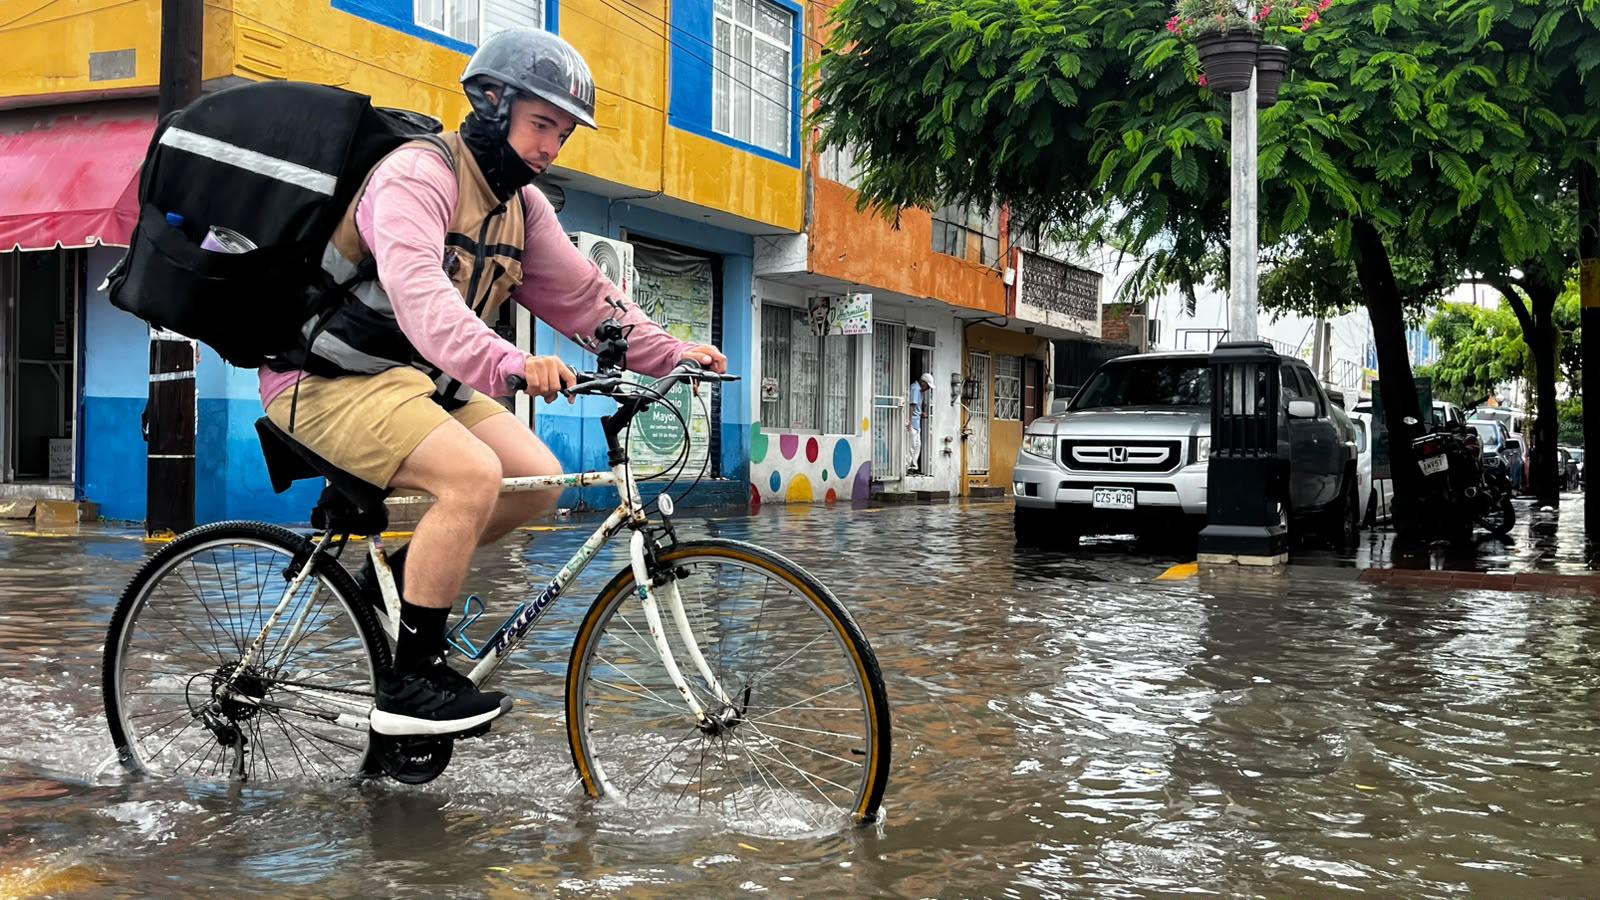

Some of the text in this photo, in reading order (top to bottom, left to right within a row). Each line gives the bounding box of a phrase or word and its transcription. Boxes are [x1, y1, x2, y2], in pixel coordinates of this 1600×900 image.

[654, 397, 682, 410] pmio
[653, 411, 676, 424] Mayor
[495, 579, 561, 659] RALEIGH
